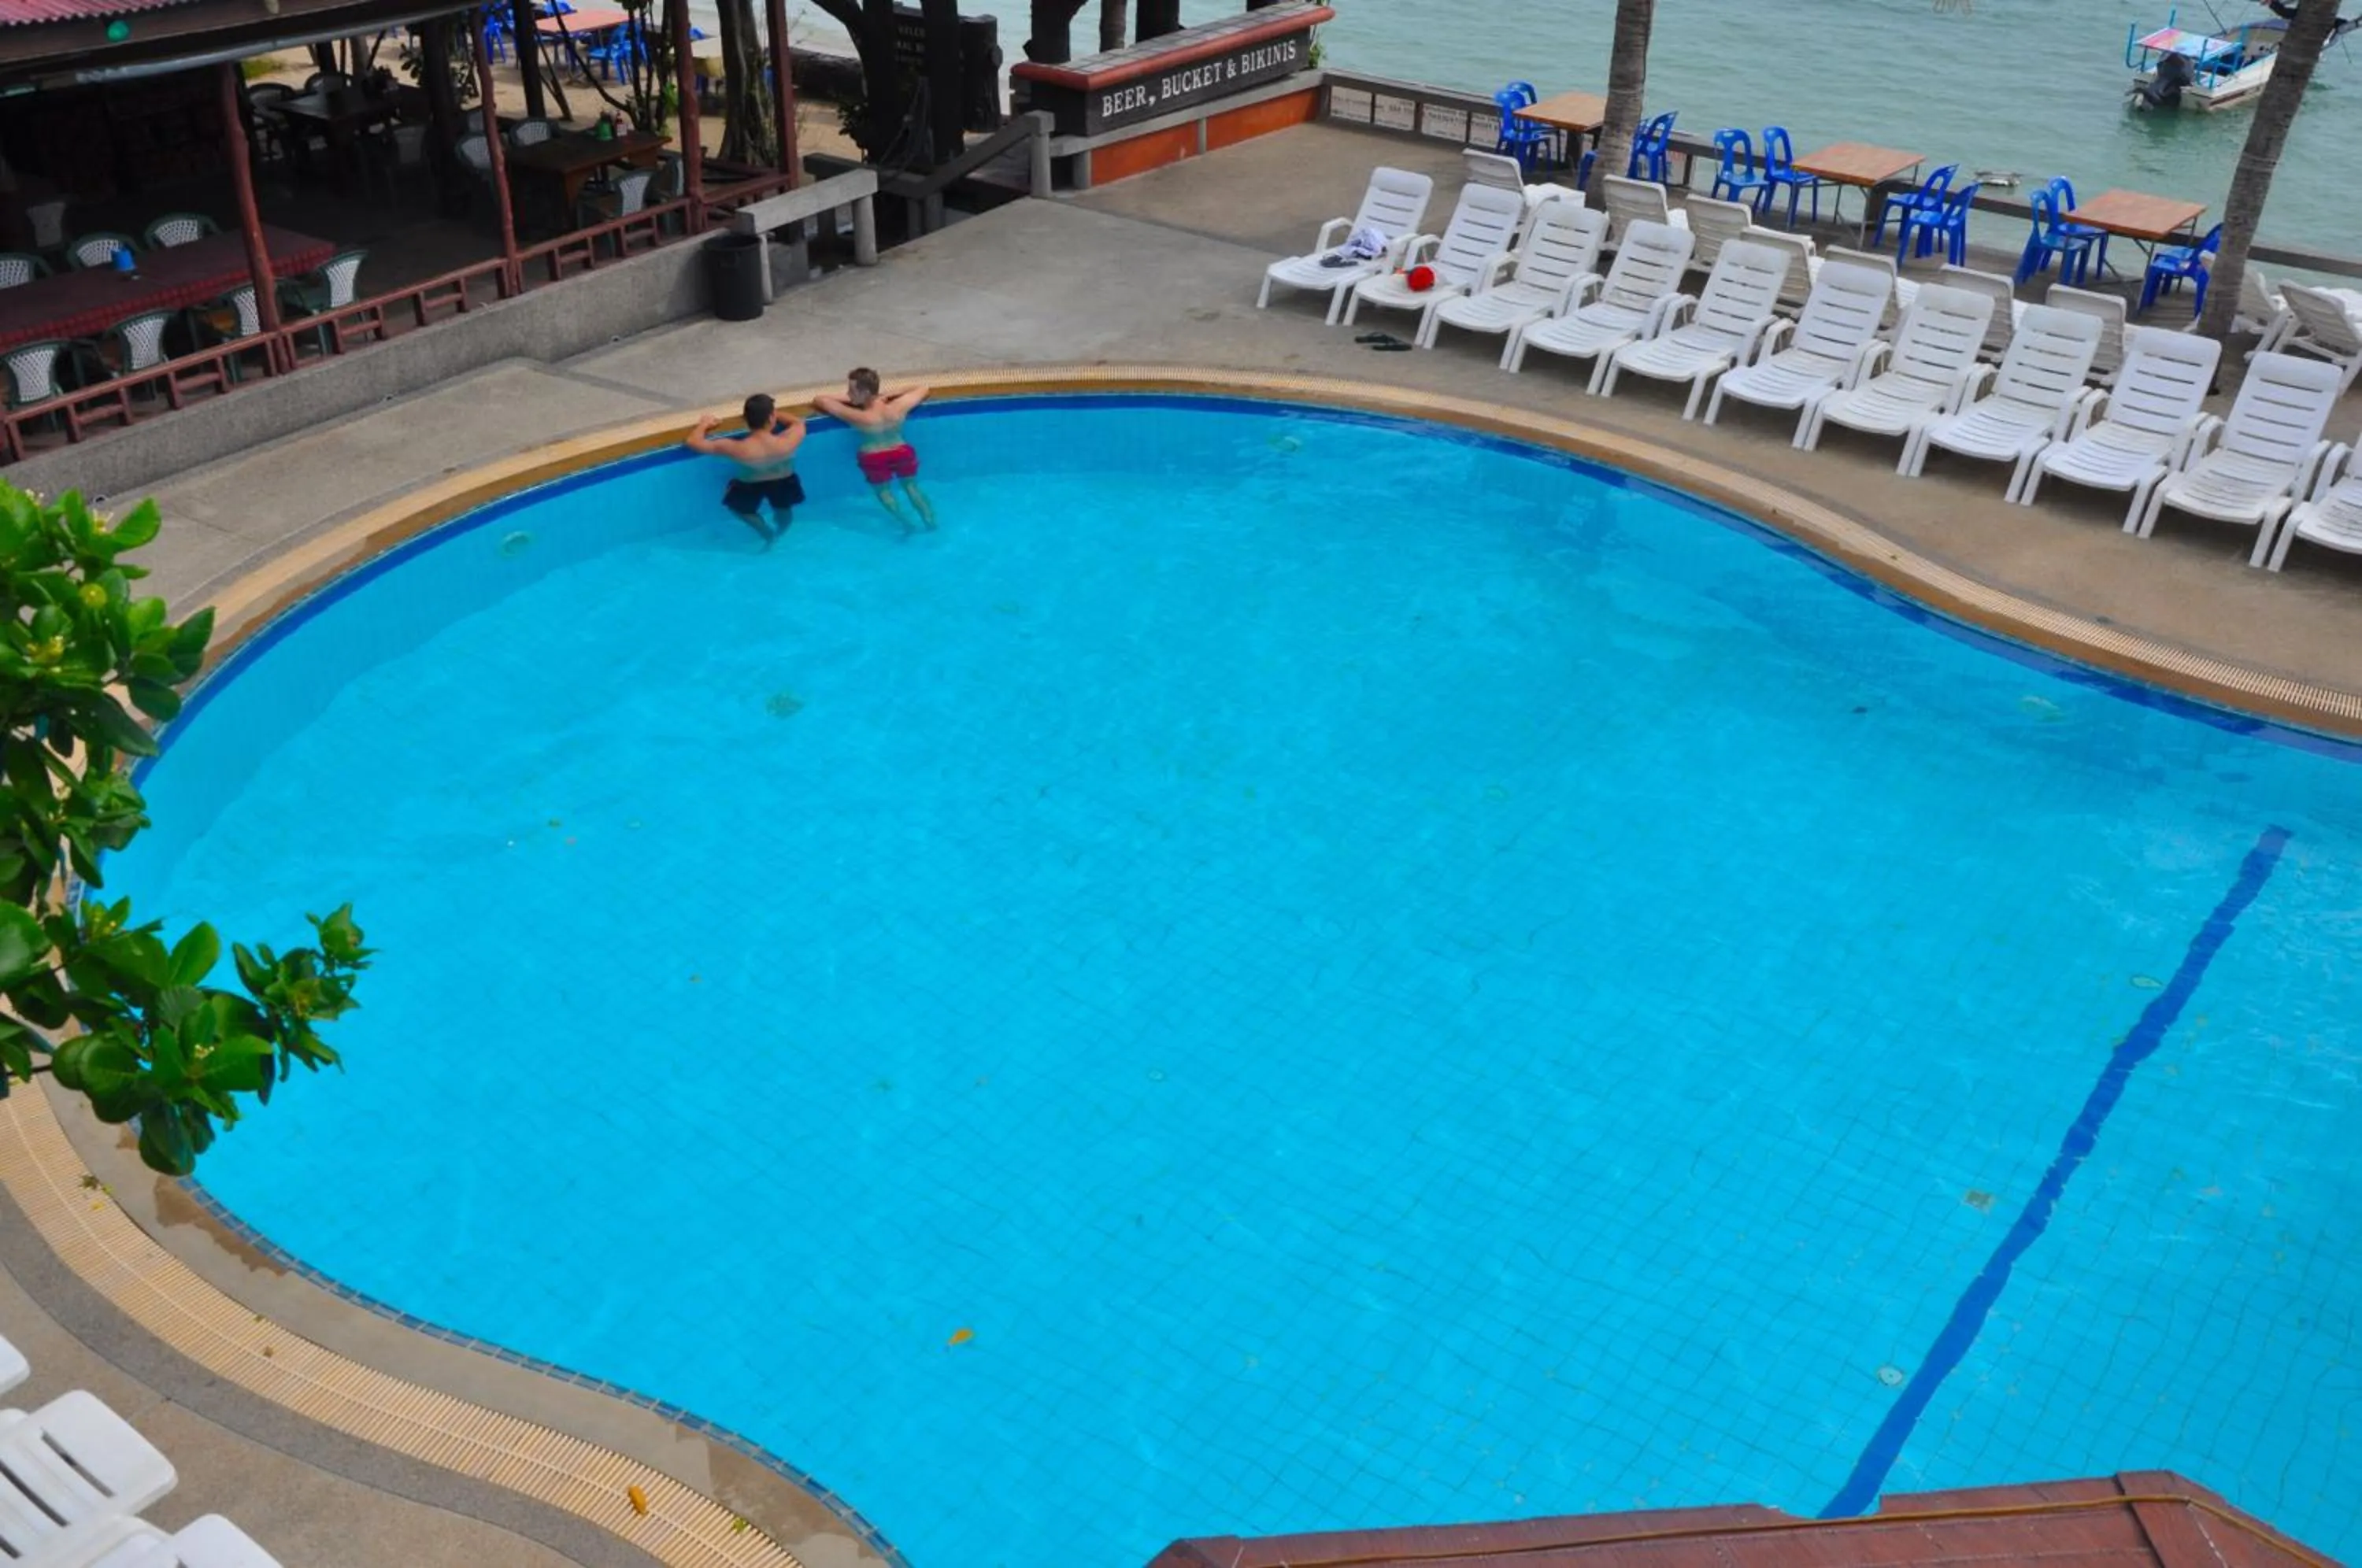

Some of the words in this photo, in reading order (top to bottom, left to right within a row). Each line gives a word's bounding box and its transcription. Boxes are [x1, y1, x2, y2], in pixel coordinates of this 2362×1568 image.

[1102, 85, 1156, 117] BEER,
[1161, 62, 1222, 99] BUCKET
[1227, 57, 1237, 79] &
[1241, 39, 1296, 74] BIKINIS
